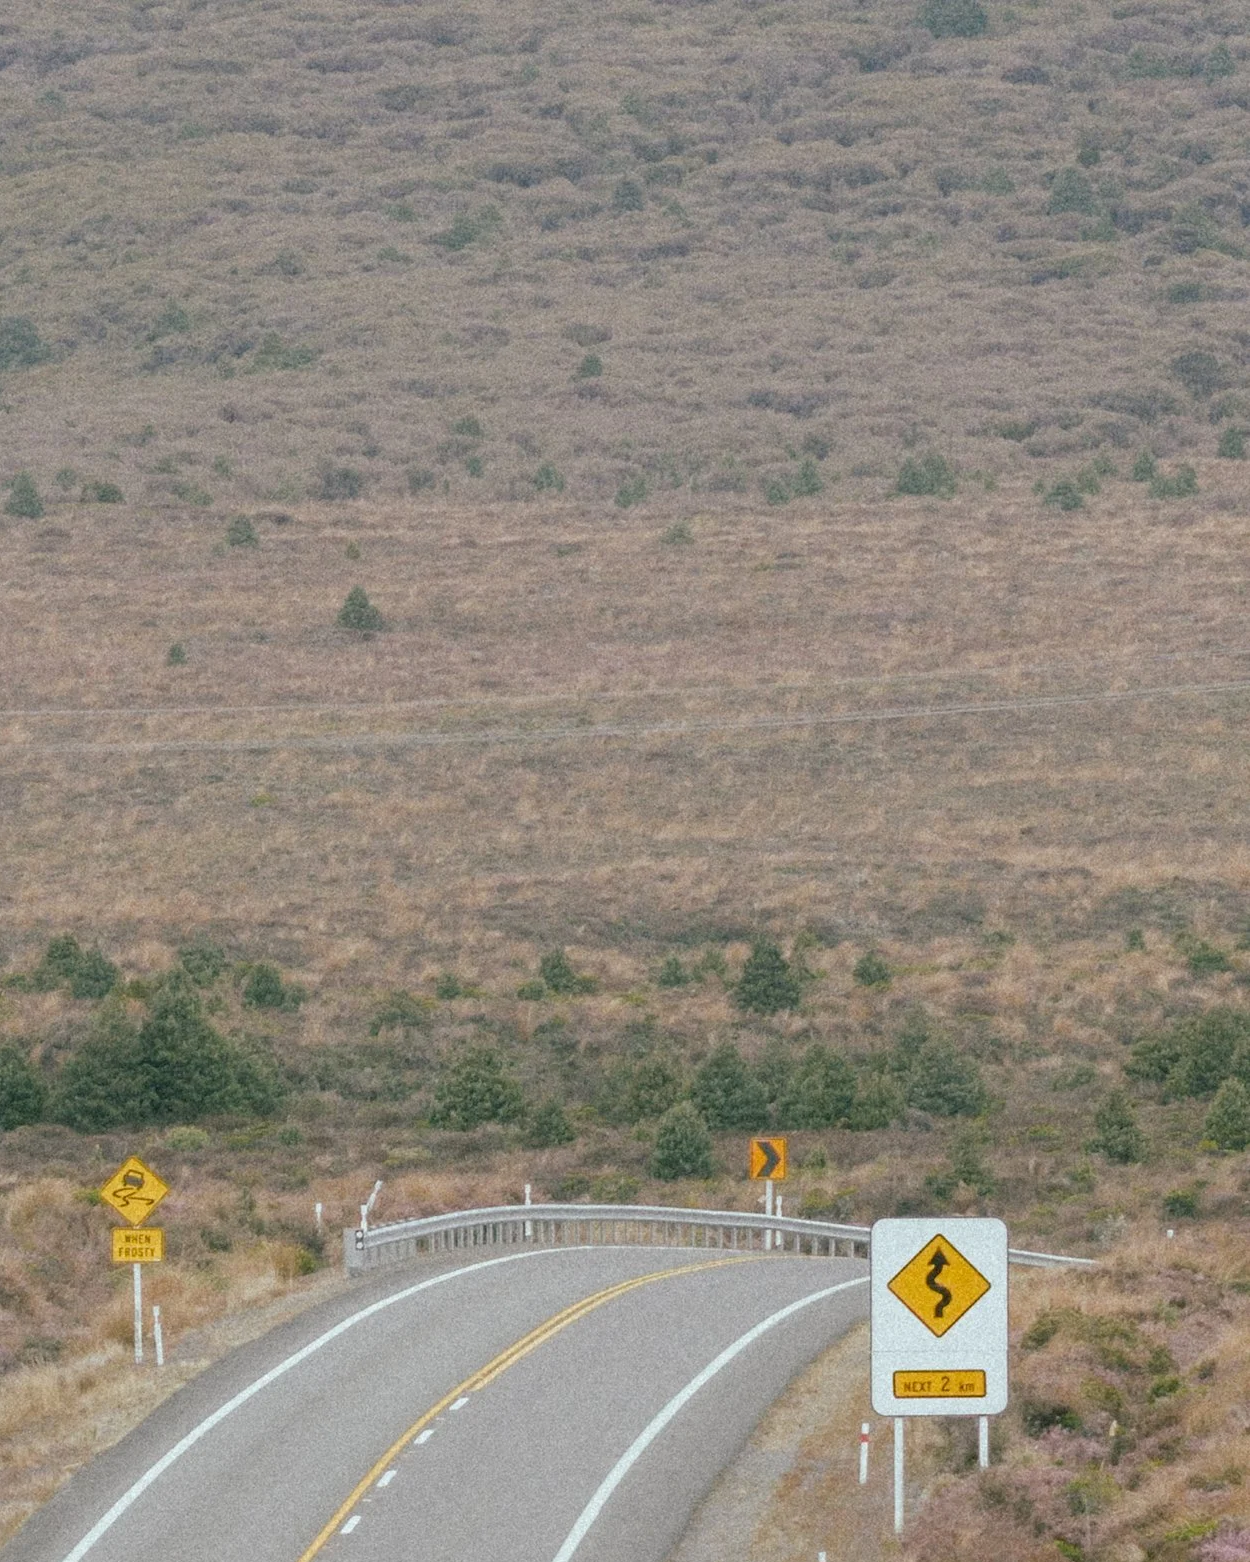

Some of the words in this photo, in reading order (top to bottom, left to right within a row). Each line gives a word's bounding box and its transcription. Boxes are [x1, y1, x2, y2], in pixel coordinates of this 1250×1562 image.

[125, 1234, 151, 1244] WHEN
[118, 1247, 156, 1257] FROSTY
[904, 1382, 932, 1392] NEXT
[941, 1376, 950, 1392] 2
[959, 1382, 975, 1392] km
